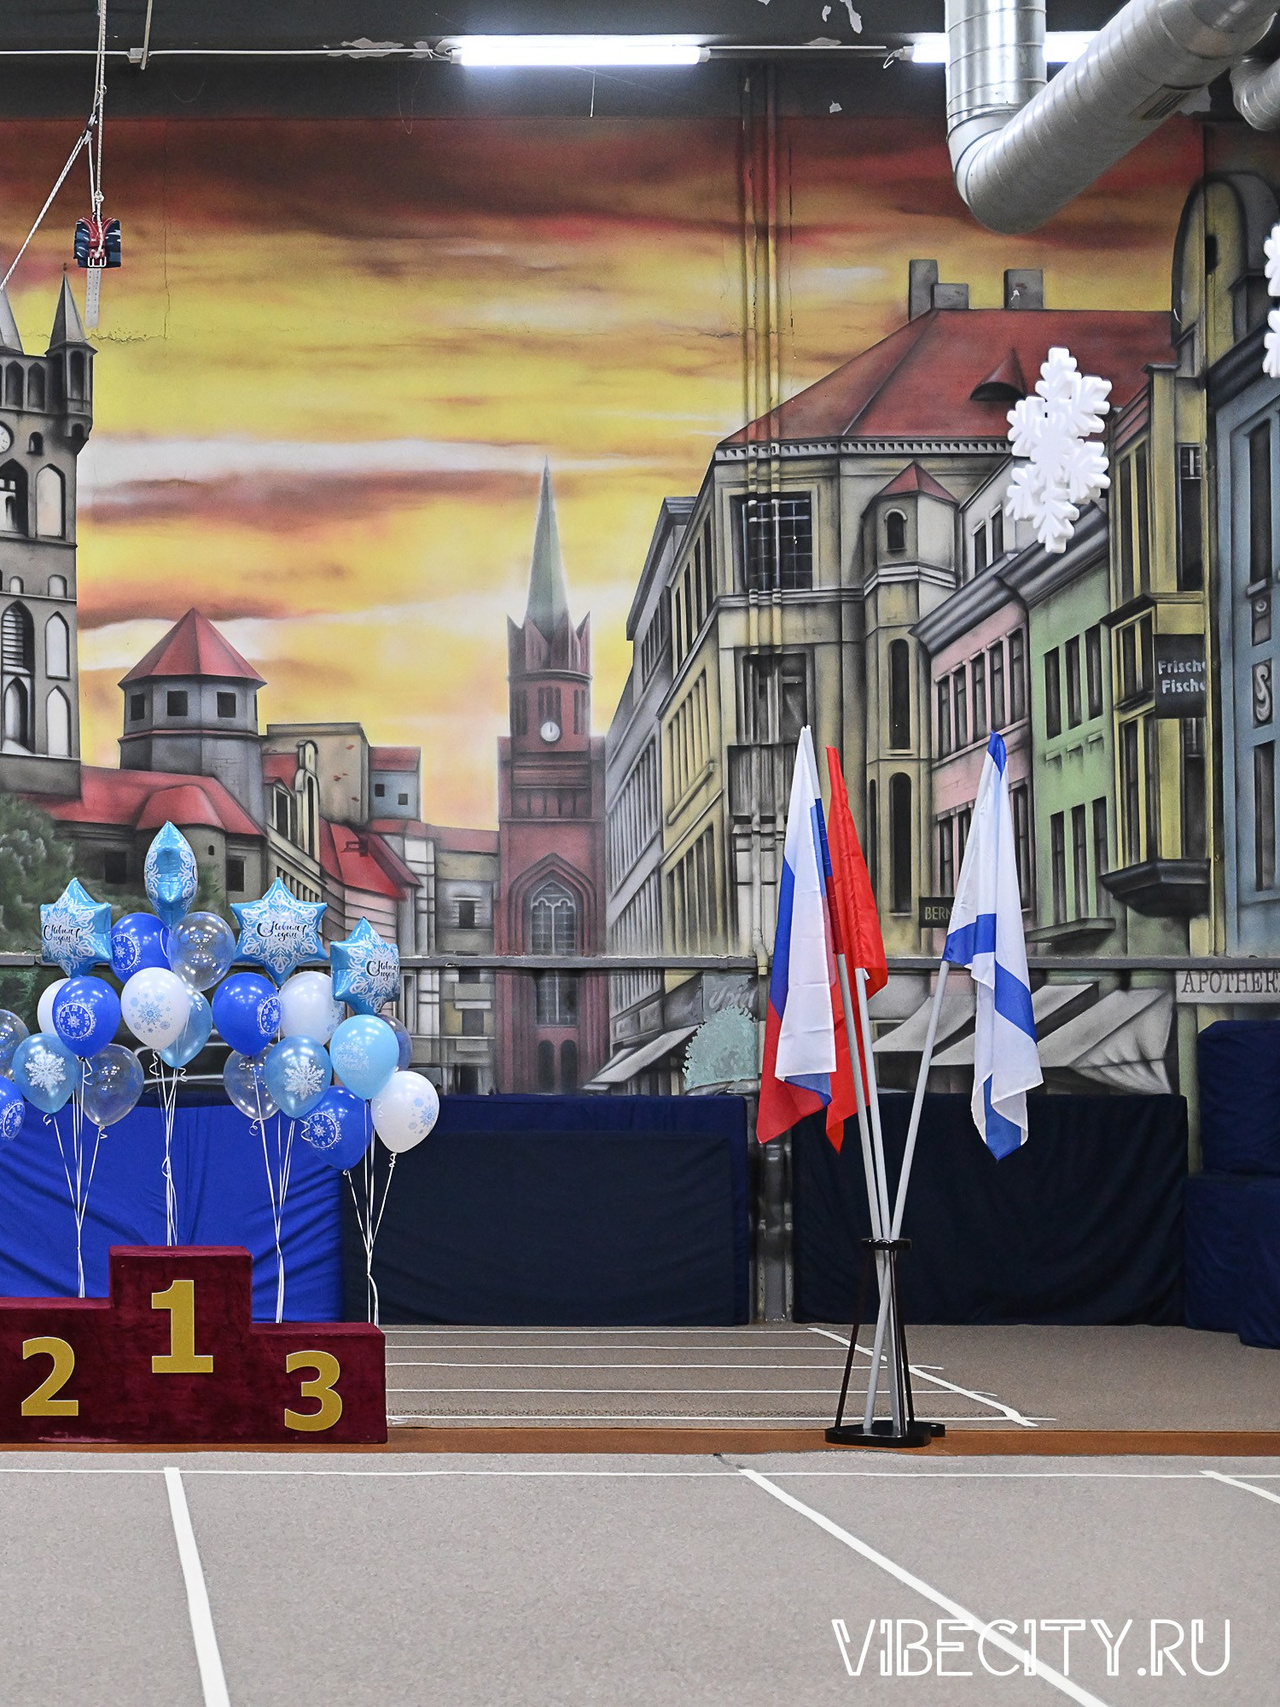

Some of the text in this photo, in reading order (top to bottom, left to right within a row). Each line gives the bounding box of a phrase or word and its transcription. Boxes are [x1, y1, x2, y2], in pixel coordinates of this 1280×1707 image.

[1181, 969, 1280, 994] APOTHEK
[151, 1279, 214, 1374] 1
[20, 1336, 80, 1417] 2
[283, 1349, 343, 1432] 3
